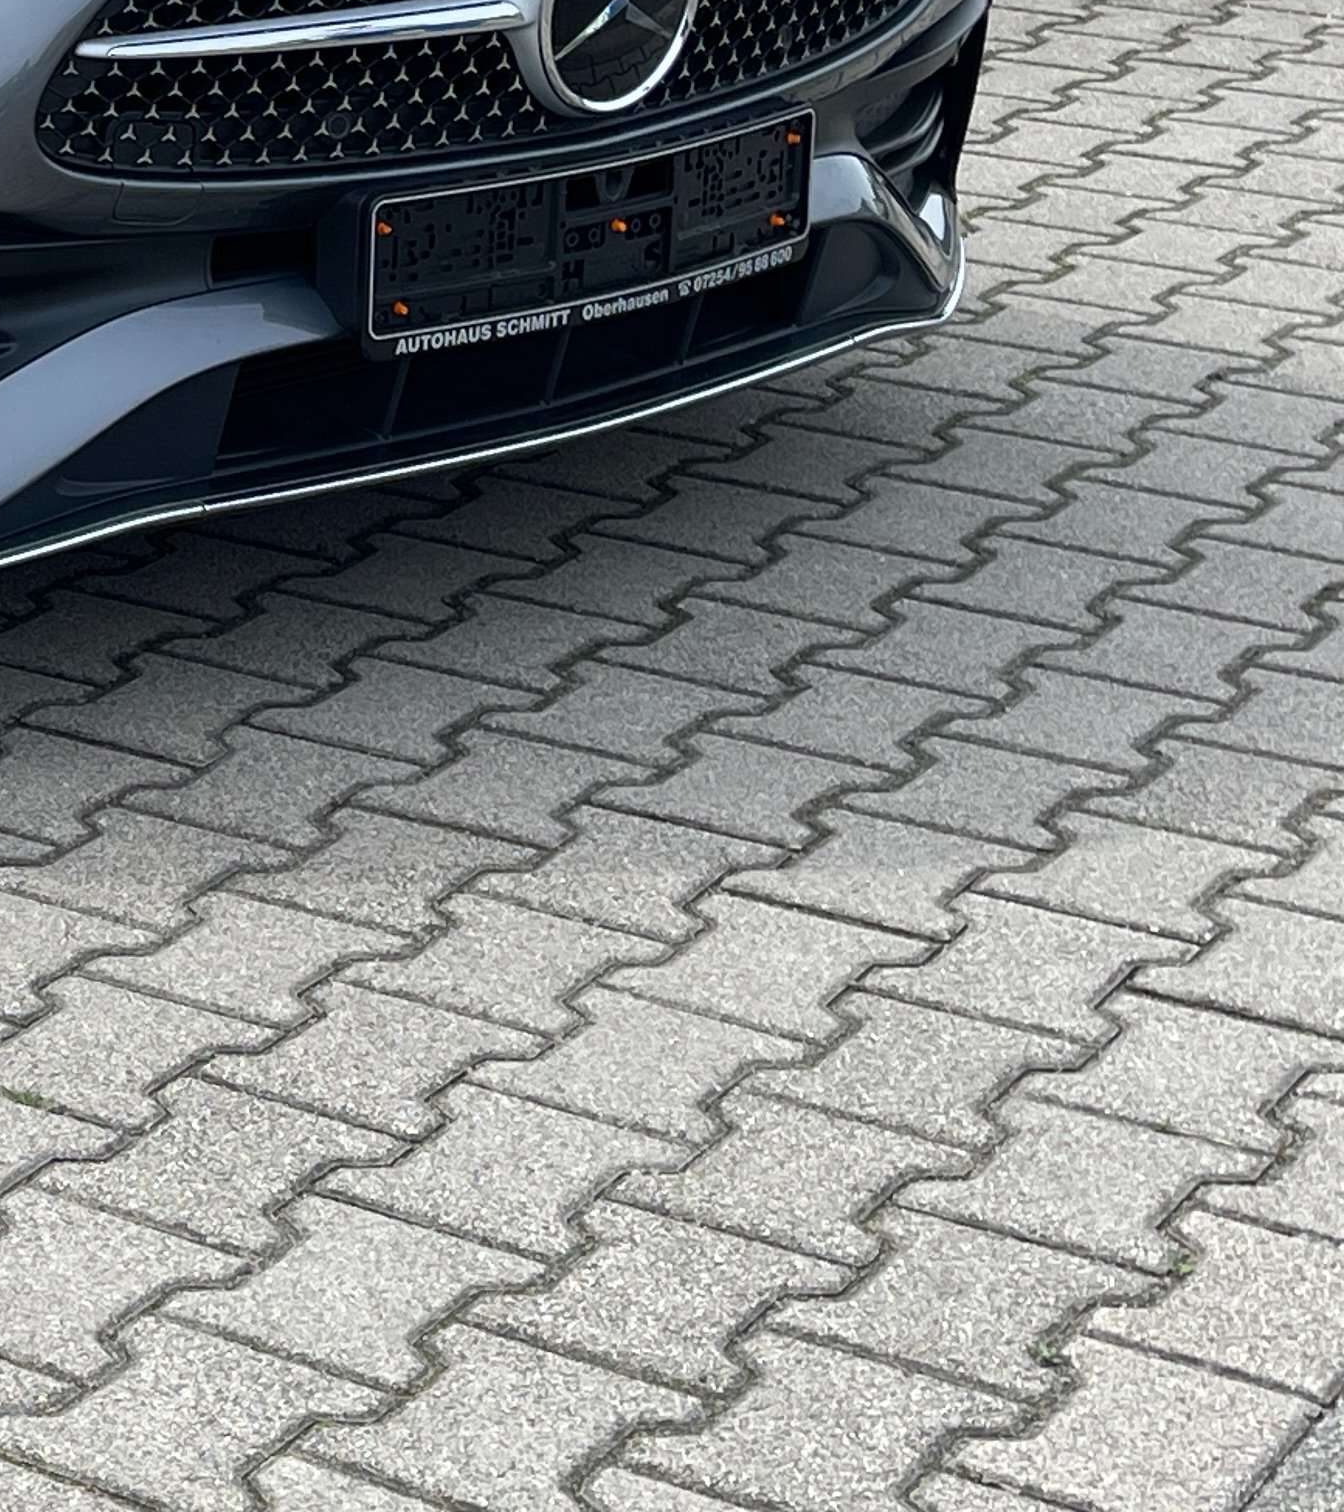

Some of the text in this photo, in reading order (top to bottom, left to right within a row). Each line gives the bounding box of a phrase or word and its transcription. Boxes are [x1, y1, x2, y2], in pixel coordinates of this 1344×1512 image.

[394, 321, 492, 356] AUTOHAUS
[495, 308, 572, 339] SCHMITT
[581, 288, 670, 322] Oberhausen
